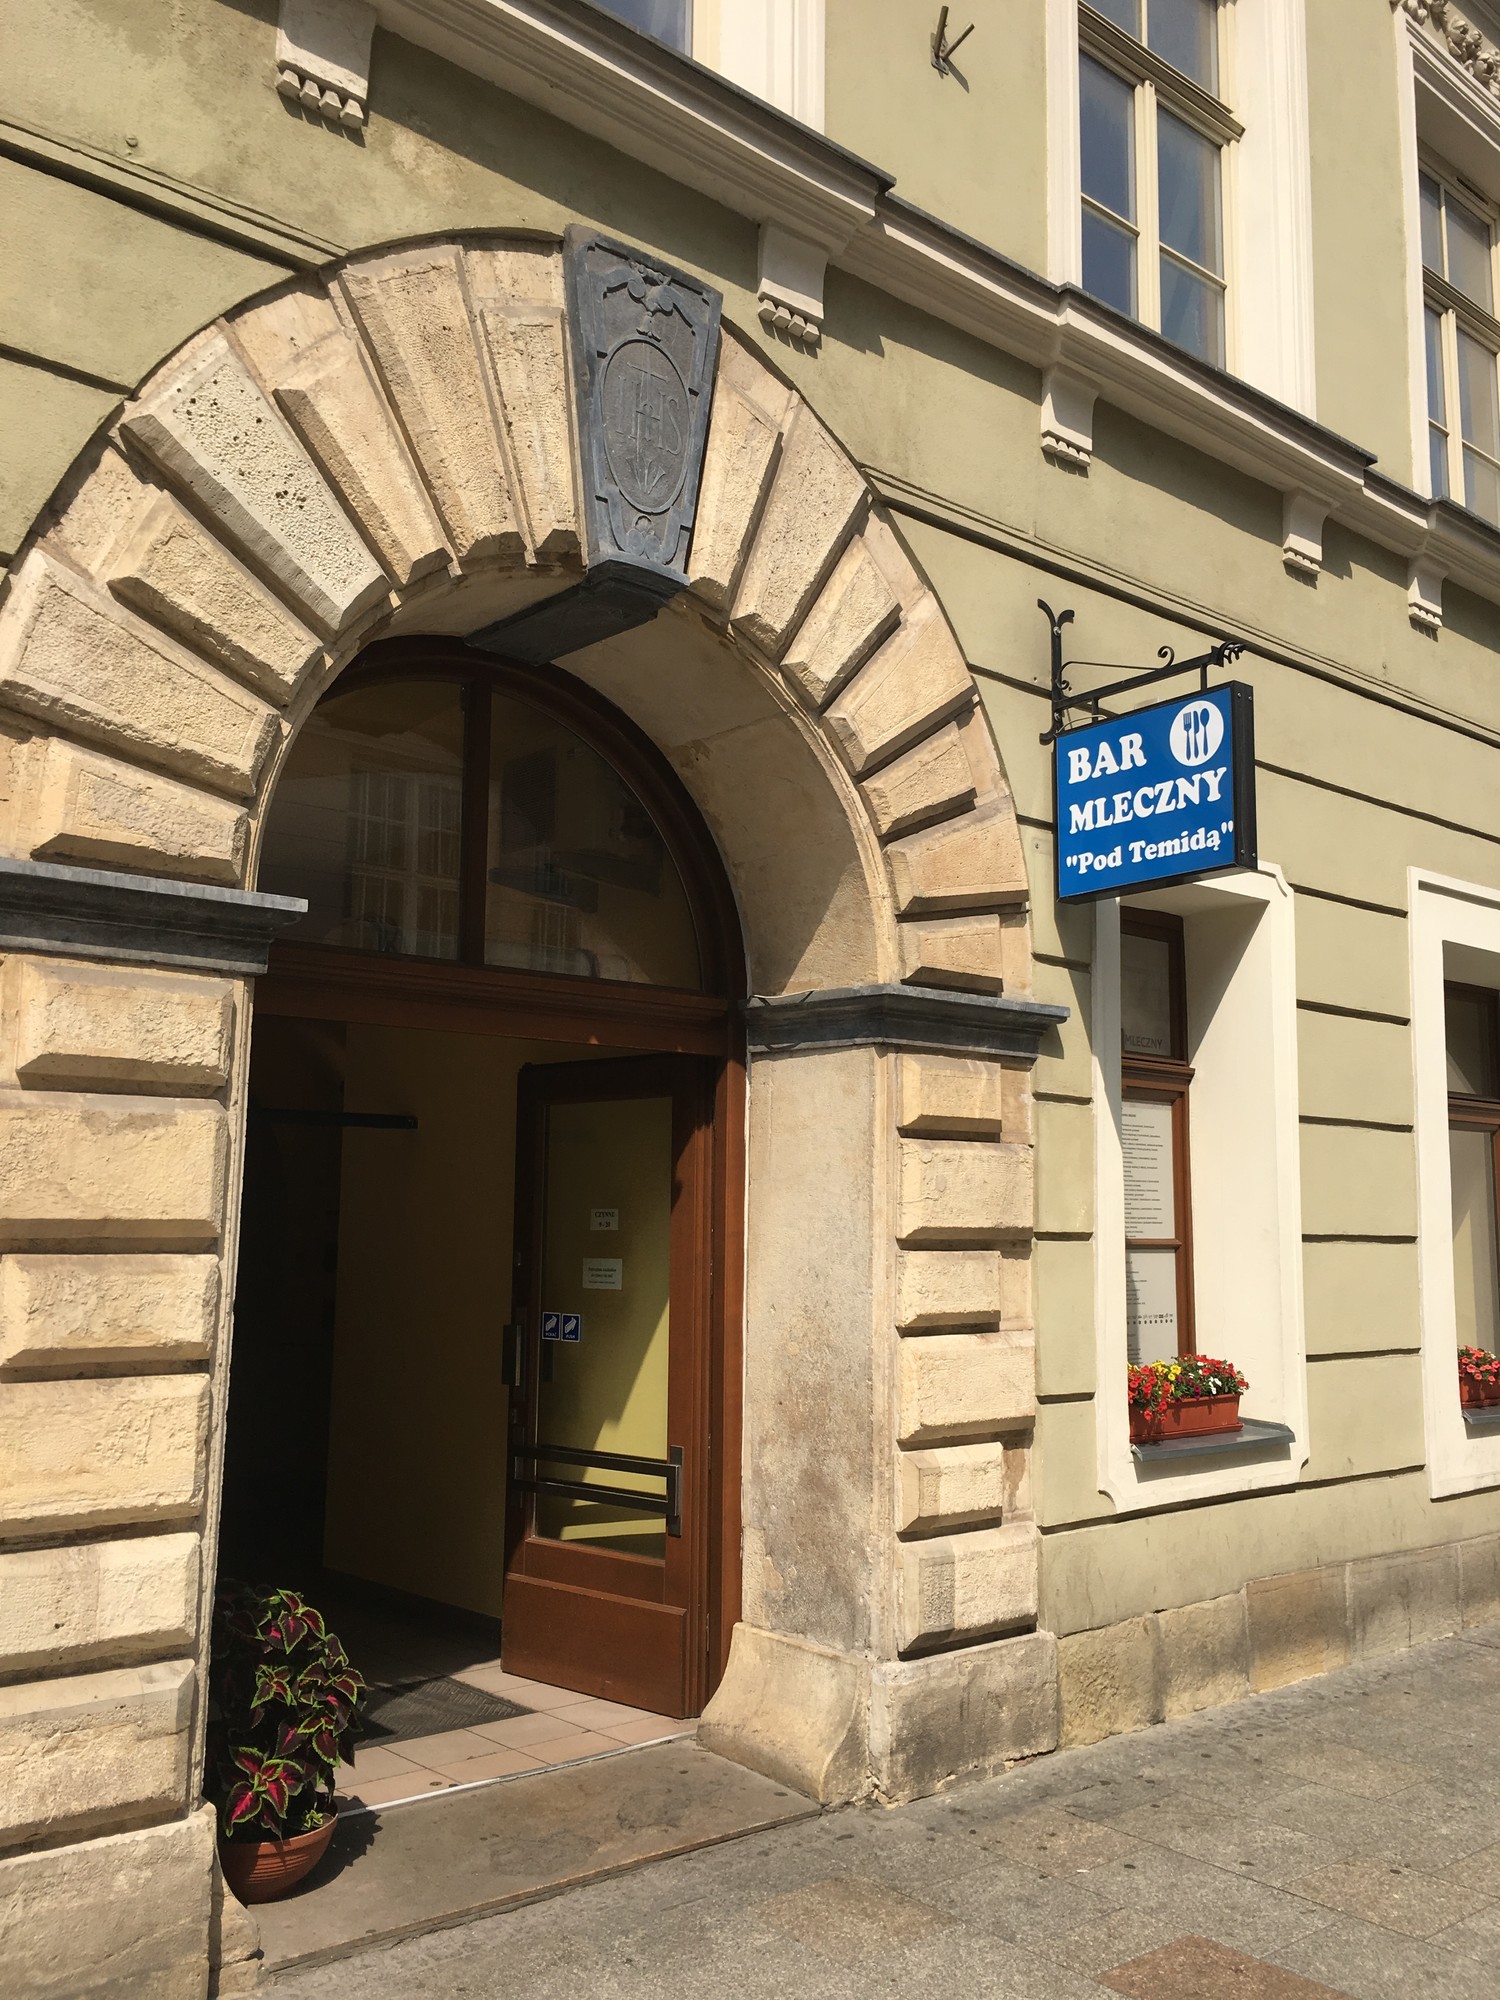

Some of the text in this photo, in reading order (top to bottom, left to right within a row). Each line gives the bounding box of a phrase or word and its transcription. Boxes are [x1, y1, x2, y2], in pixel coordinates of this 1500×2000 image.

[1067, 732, 1147, 784] BAR
[1068, 766, 1227, 834] MLECZNY
[1066, 820, 1234, 874] "Pod Temidą"
[1125, 1034, 1163, 1049] MLECZNY
